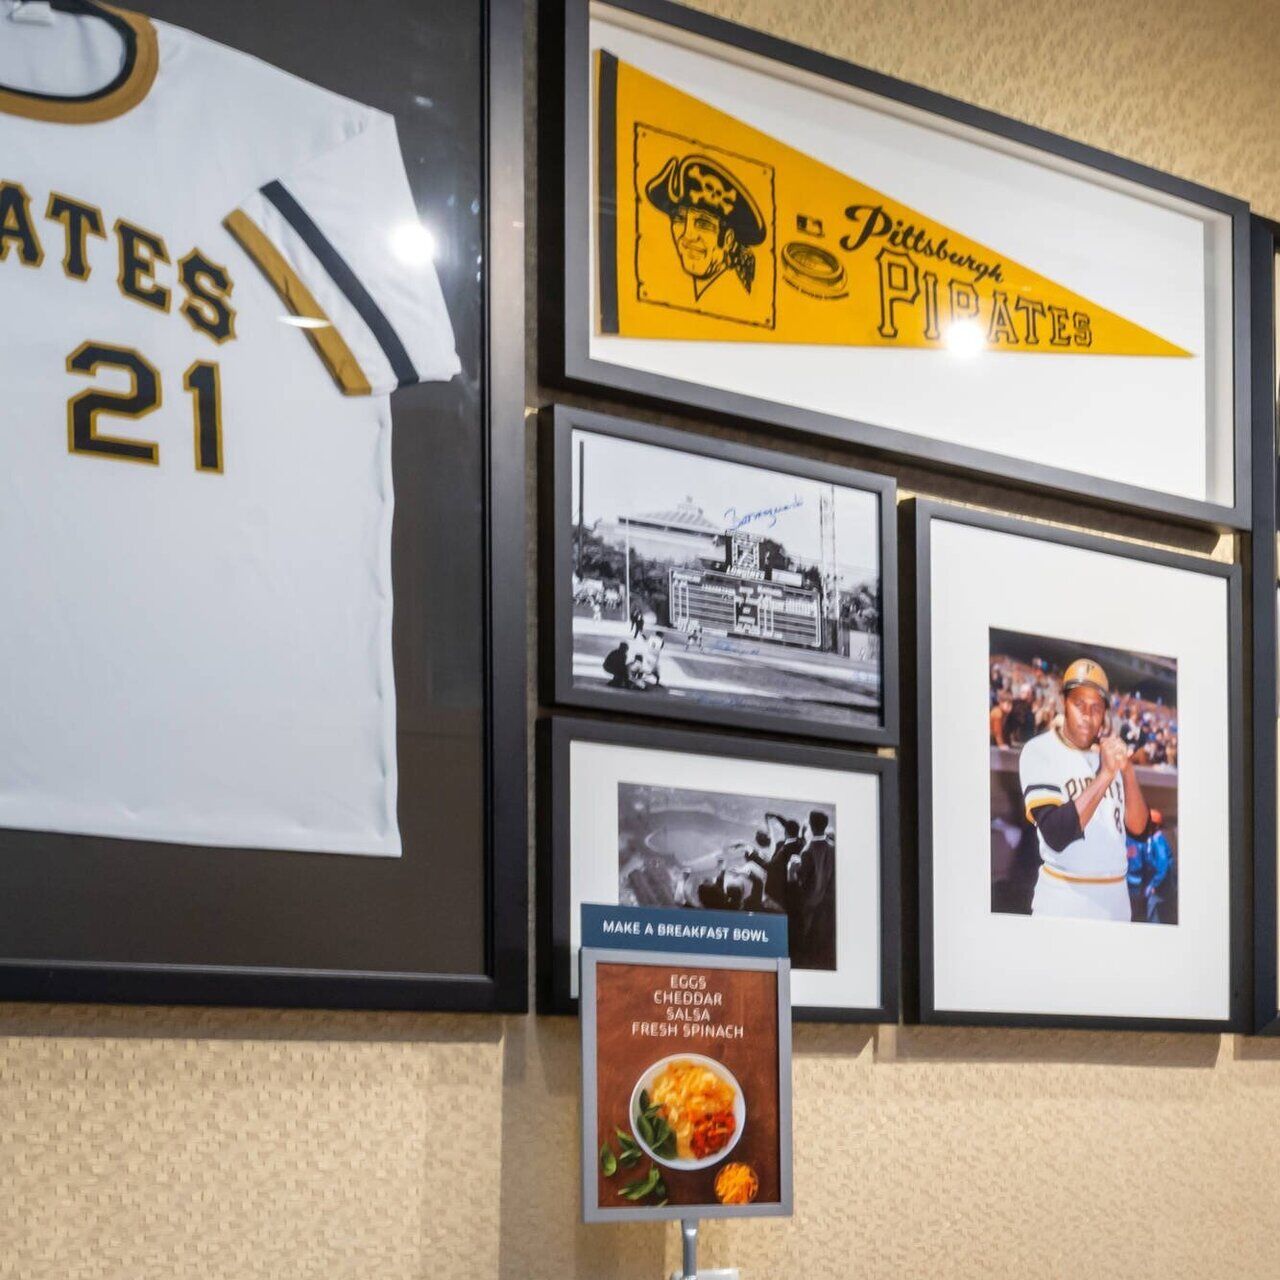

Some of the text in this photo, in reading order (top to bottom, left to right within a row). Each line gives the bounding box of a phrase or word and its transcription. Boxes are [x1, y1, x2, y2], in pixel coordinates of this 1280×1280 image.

[839, 204, 1004, 283] Pittsburgh
[875, 246, 1093, 347] PIRATES
[65, 339, 224, 475] 21
[603, 919, 770, 943] MAKE A BREAKFAST BOWL
[670, 974, 708, 990] EGGS
[653, 990, 724, 1006] CHEDDAR
[666, 1006, 711, 1021] SALSA
[631, 1021, 744, 1039] FRESH SPINACH
